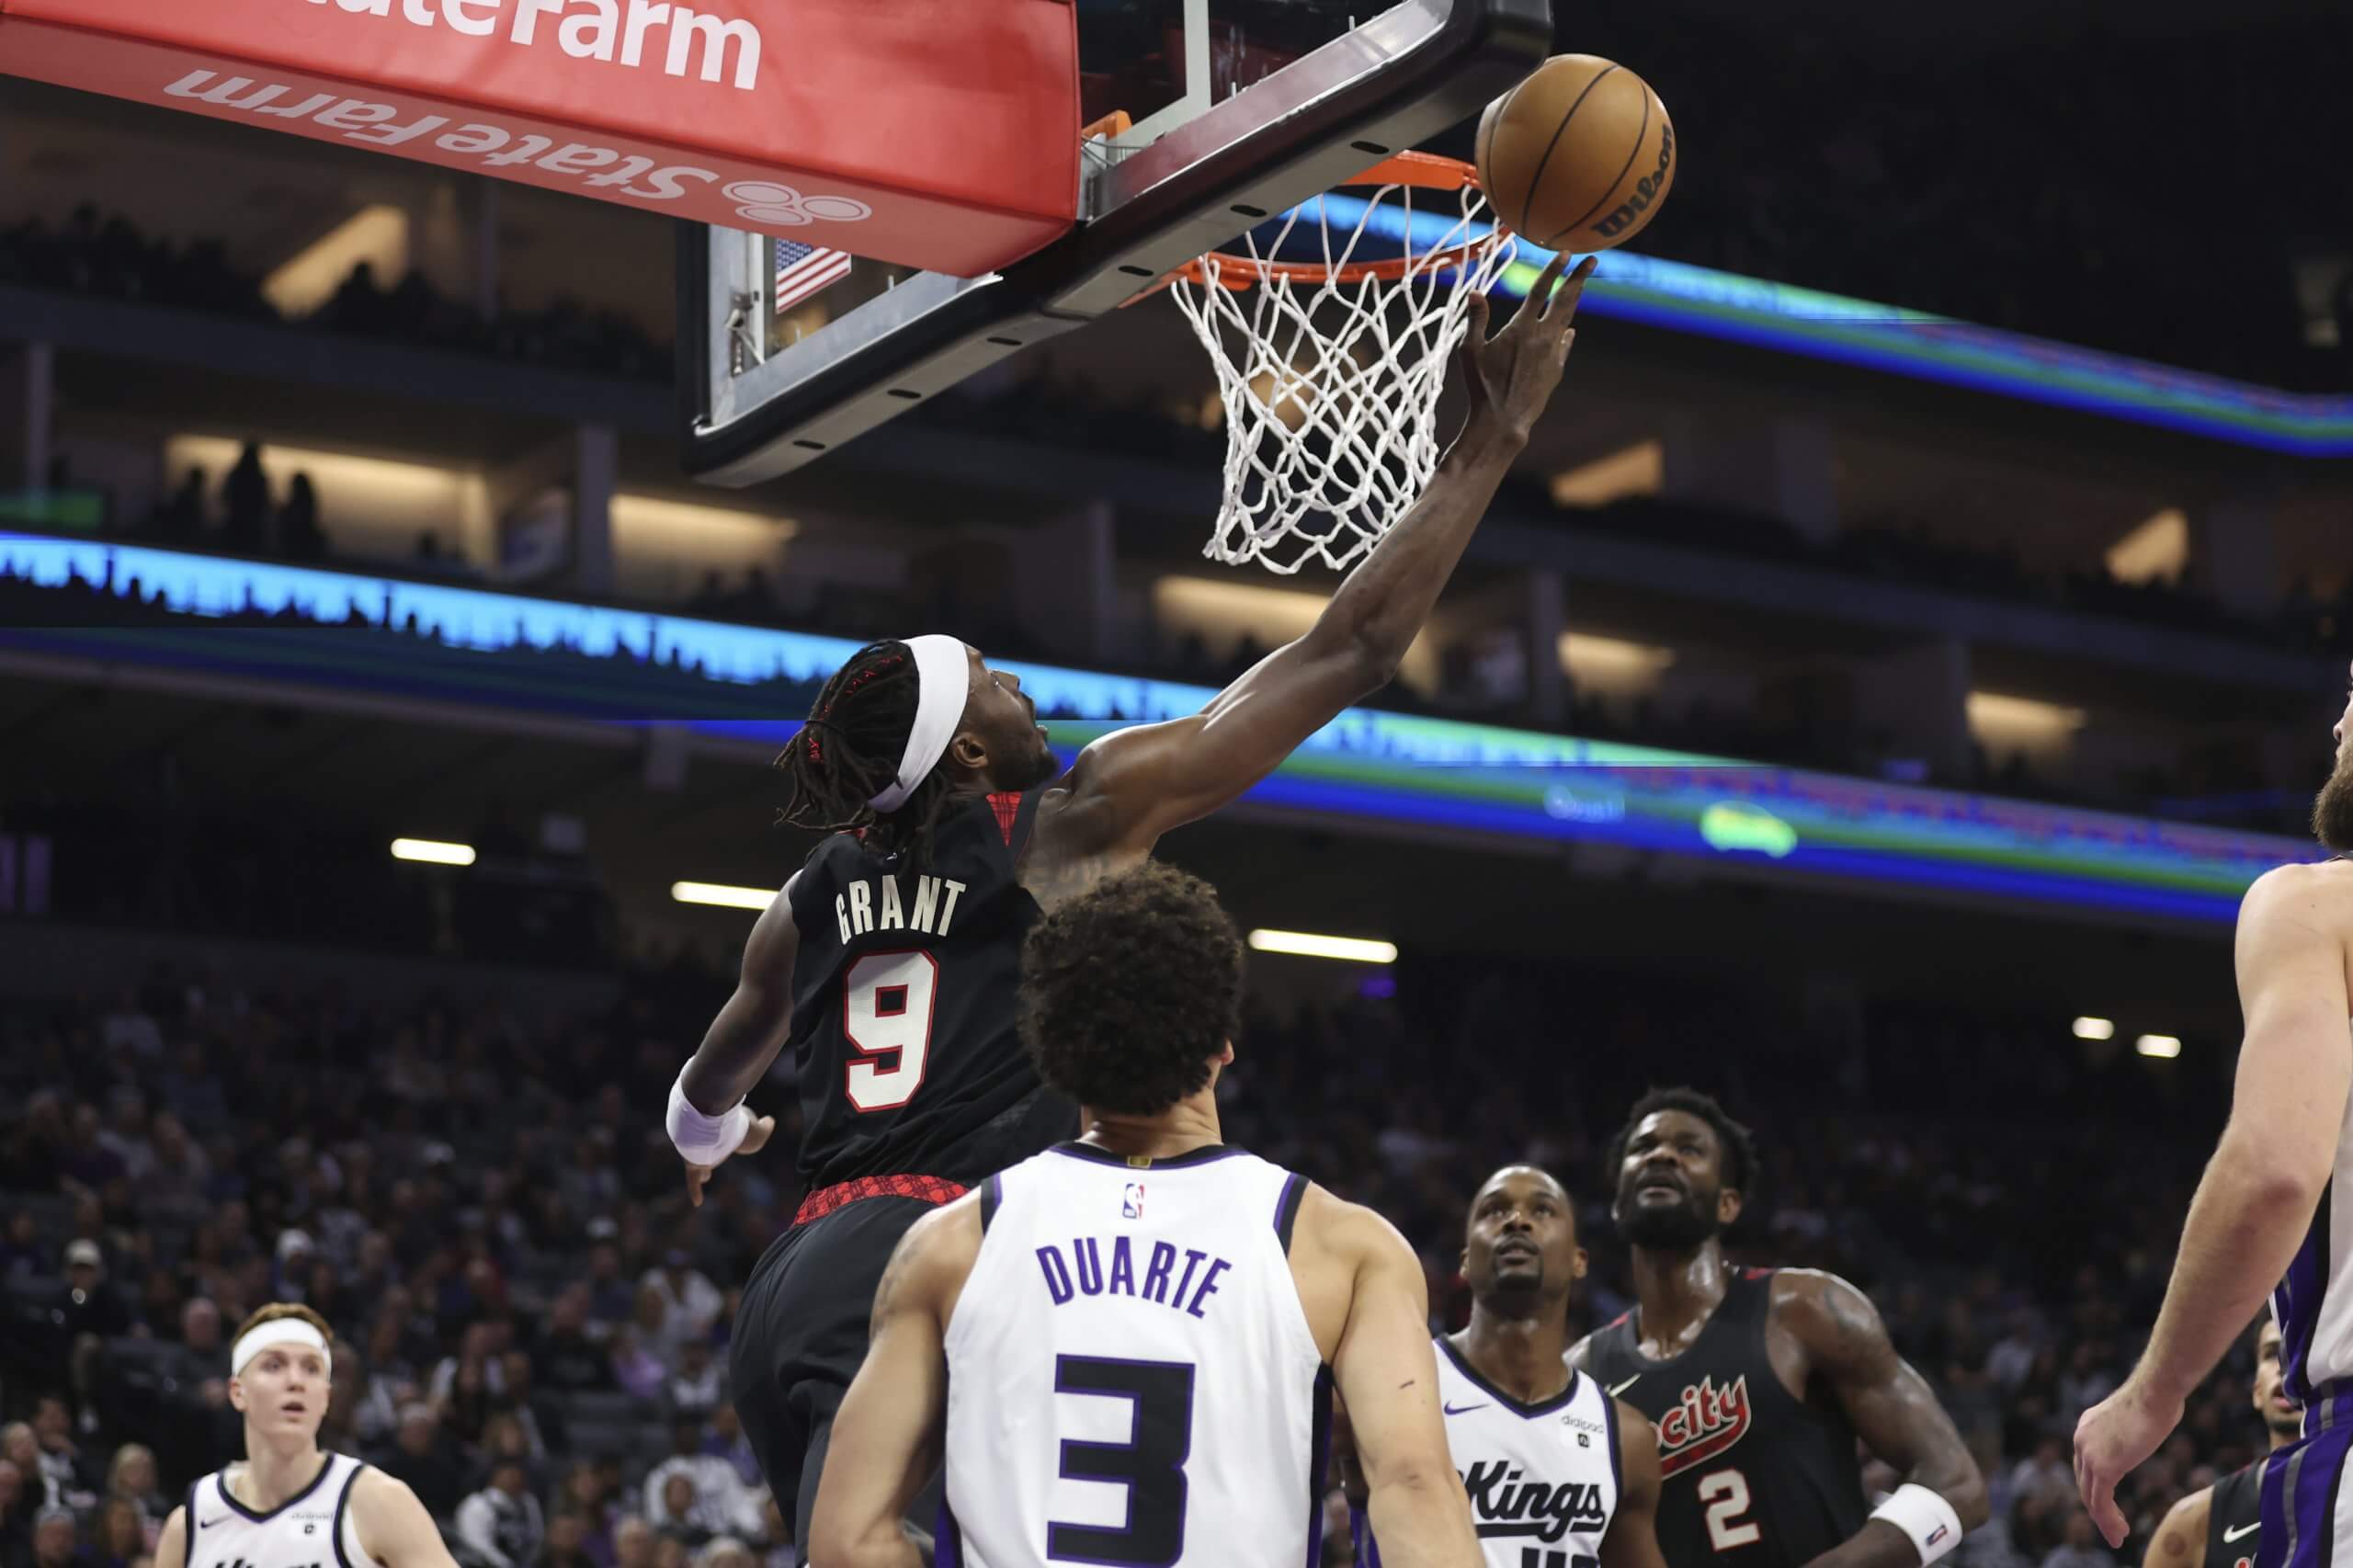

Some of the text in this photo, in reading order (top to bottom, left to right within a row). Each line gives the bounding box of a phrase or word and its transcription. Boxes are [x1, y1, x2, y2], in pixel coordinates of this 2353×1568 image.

[1591, 122, 1673, 237] Wilson
[835, 874, 967, 946] GRANT
[843, 948, 939, 1114] 9
[1036, 1235, 1233, 1319] DUARTE
[1046, 1353, 1196, 1568] 3
[1464, 1460, 1606, 1543] Kings
[1697, 1466, 1762, 1553] 2
